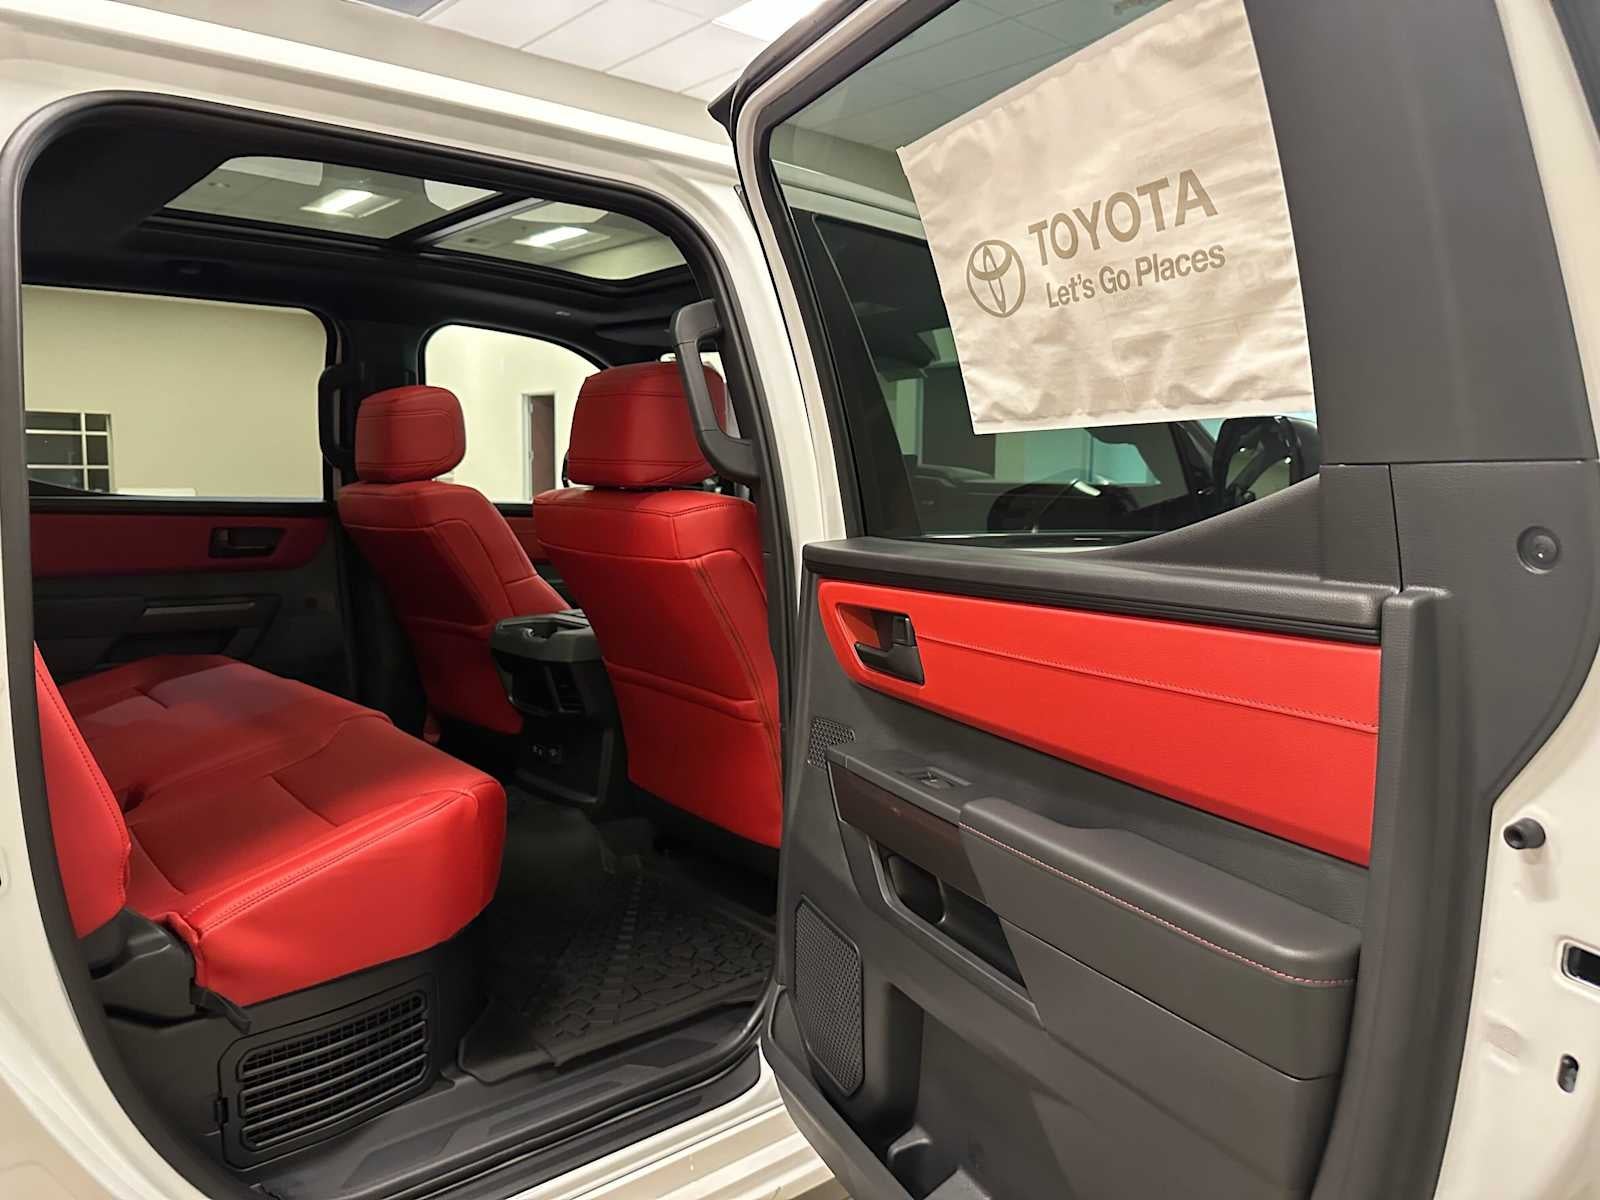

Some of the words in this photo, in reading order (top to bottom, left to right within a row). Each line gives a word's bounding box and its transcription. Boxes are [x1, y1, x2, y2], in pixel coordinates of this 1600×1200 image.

[1028, 169, 1218, 266] TOYOTA
[1046, 274, 1095, 308] Let's
[1099, 265, 1130, 294] Go
[1135, 244, 1226, 286] Places
